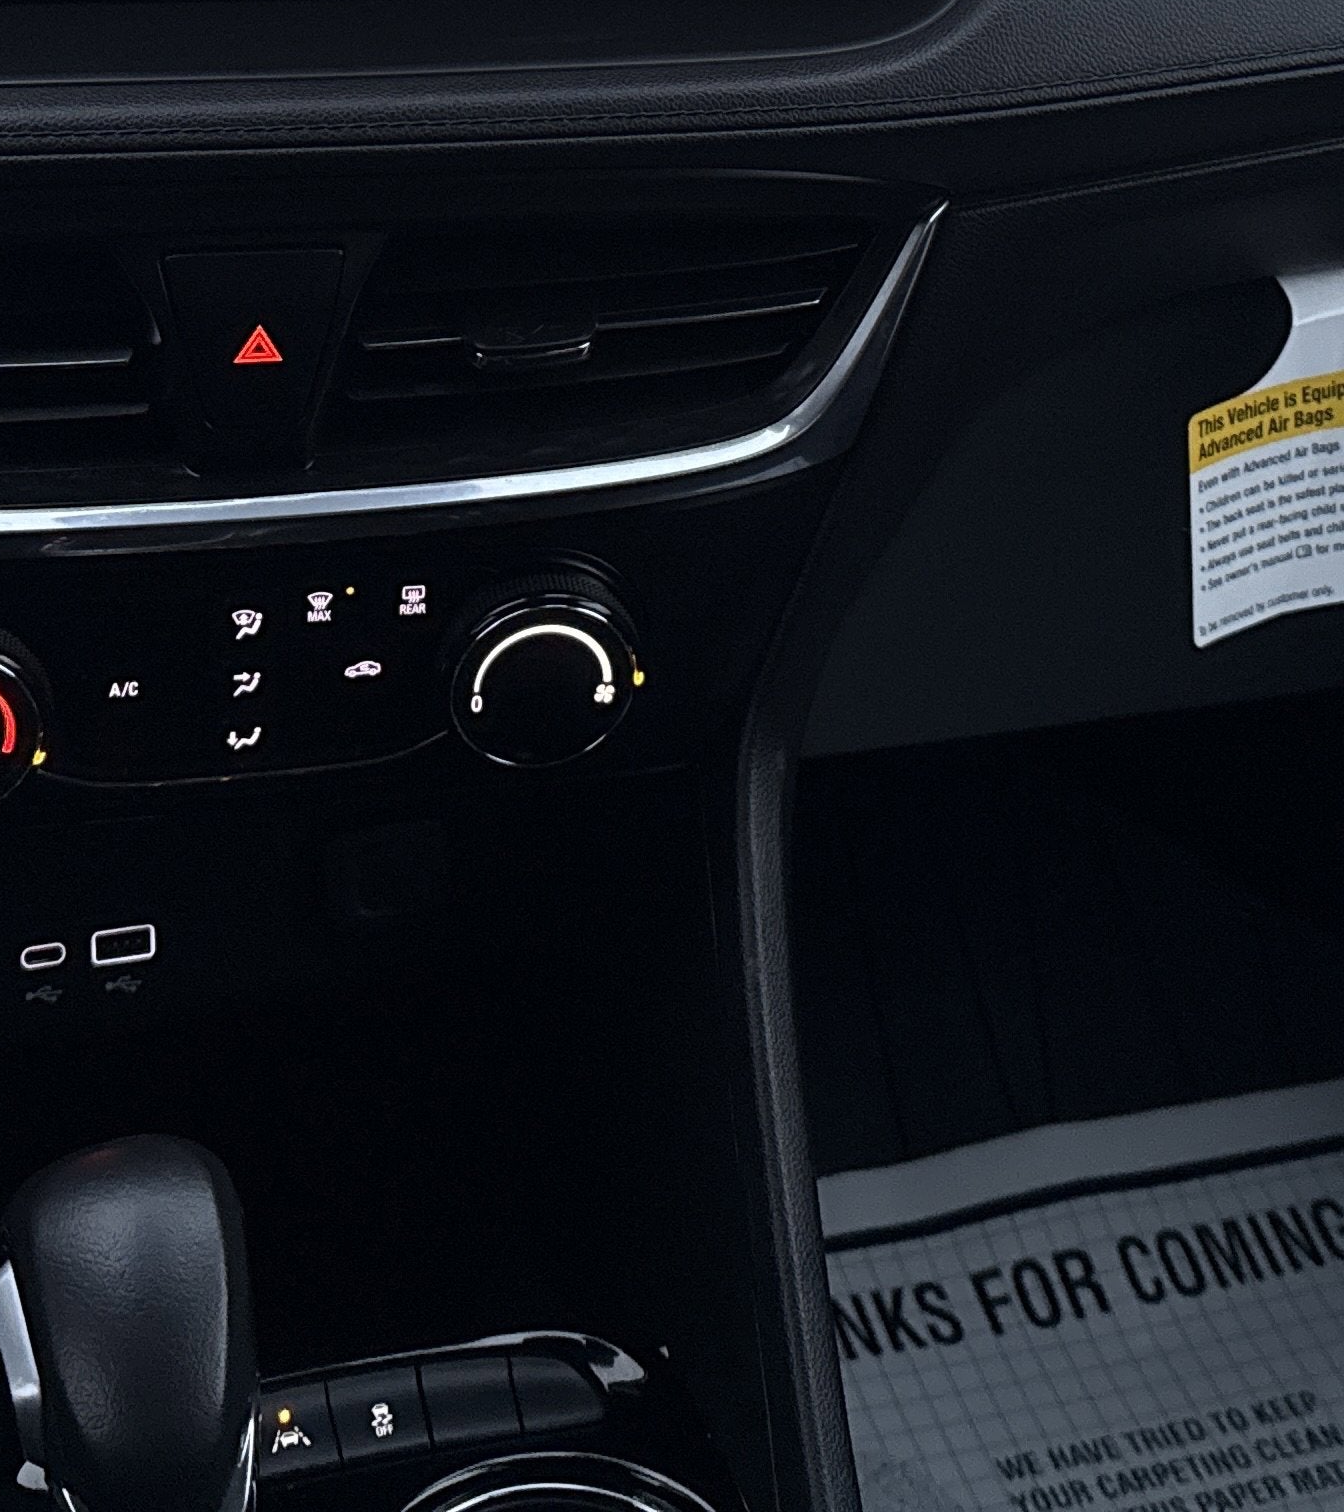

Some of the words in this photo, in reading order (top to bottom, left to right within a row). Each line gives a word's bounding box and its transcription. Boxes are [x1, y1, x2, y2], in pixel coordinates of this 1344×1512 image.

[1197, 414, 1225, 438] This
[1227, 394, 1280, 425] Vehicle
[1283, 391, 1297, 409] is
[1198, 425, 1264, 461] Advanced
[1267, 416, 1289, 435] Air
[1293, 406, 1334, 428] Bags
[307, 609, 332, 623] MAX
[399, 602, 426, 616] REAR
[109, 681, 139, 699] A/C
[470, 694, 483, 713] 0
[969, 1247, 1112, 1337] FOR
[375, 1424, 393, 1437] OFF
[995, 1450, 1043, 1481] WE
[1047, 1433, 1123, 1472] HAVE
[1122, 1416, 1208, 1456] TRIED
[1209, 1405, 1251, 1435] TO
[1251, 1390, 1316, 1426] KEEP
[1009, 1479, 1095, 1512] YOUR
[1096, 1442, 1253, 1502] CARPETING
[1193, 1473, 1289, 1512] PAPER
